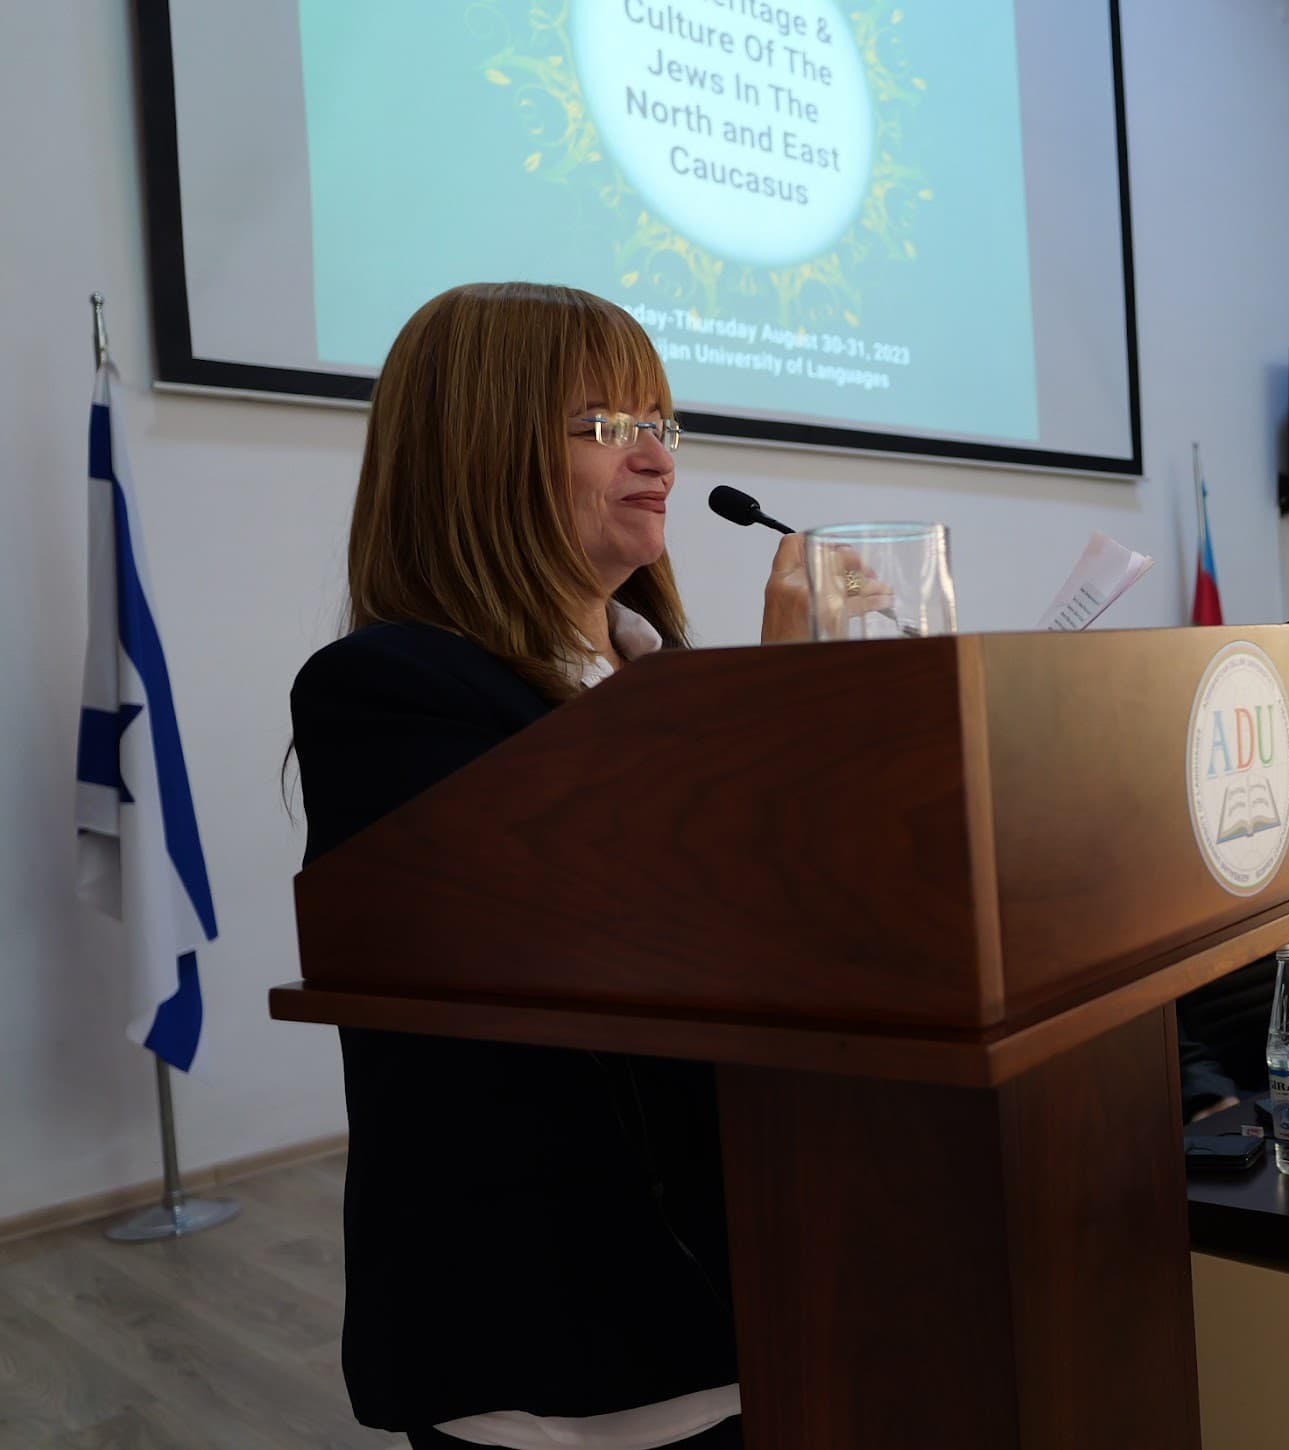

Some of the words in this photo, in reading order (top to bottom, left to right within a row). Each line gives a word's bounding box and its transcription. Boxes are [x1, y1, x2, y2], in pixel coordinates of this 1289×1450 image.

[625, 0, 735, 54] Culture
[744, 34, 774, 67] Of
[784, 46, 832, 86] The
[816, 17, 833, 44] &
[648, 48, 724, 94] Jews
[735, 72, 759, 106] In
[768, 84, 819, 123] The
[626, 85, 712, 136] North
[723, 121, 772, 153] and
[783, 131, 840, 172] East
[670, 145, 809, 205] Caucasus
[695, 343, 783, 377] University
[786, 356, 803, 375] of
[806, 360, 891, 390] Languages
[760, 324, 818, 351] August
[873, 342, 911, 366] 2023
[1207, 704, 1275, 776] ADU
